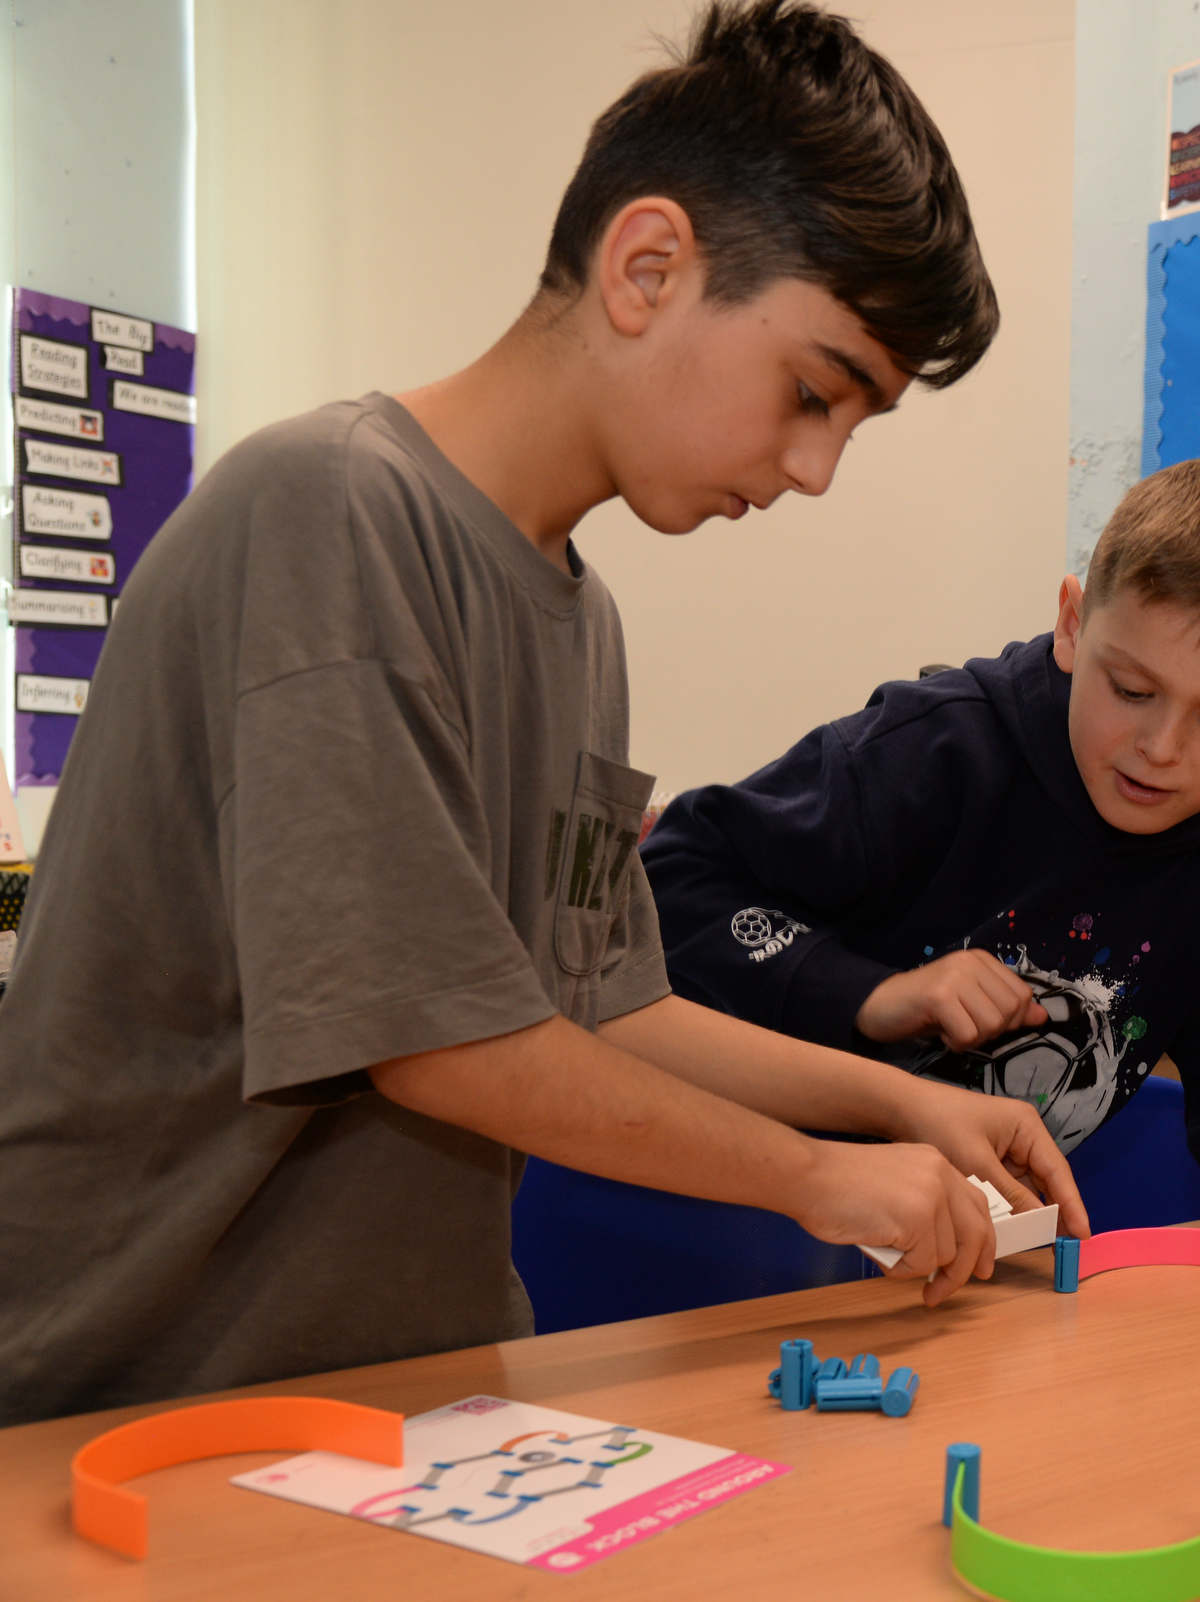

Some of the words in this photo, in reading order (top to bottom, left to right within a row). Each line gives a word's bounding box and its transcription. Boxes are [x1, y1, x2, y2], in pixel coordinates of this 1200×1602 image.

[97, 319, 119, 337] The
[30, 342, 78, 369] Reading
[109, 349, 137, 369] Read
[20, 403, 77, 428] Predicting
[31, 447, 70, 472] Making
[73, 455, 100, 472] Links
[32, 491, 74, 511] Asking
[25, 551, 83, 574] Clarifying
[21, 682, 71, 704] Inferring
